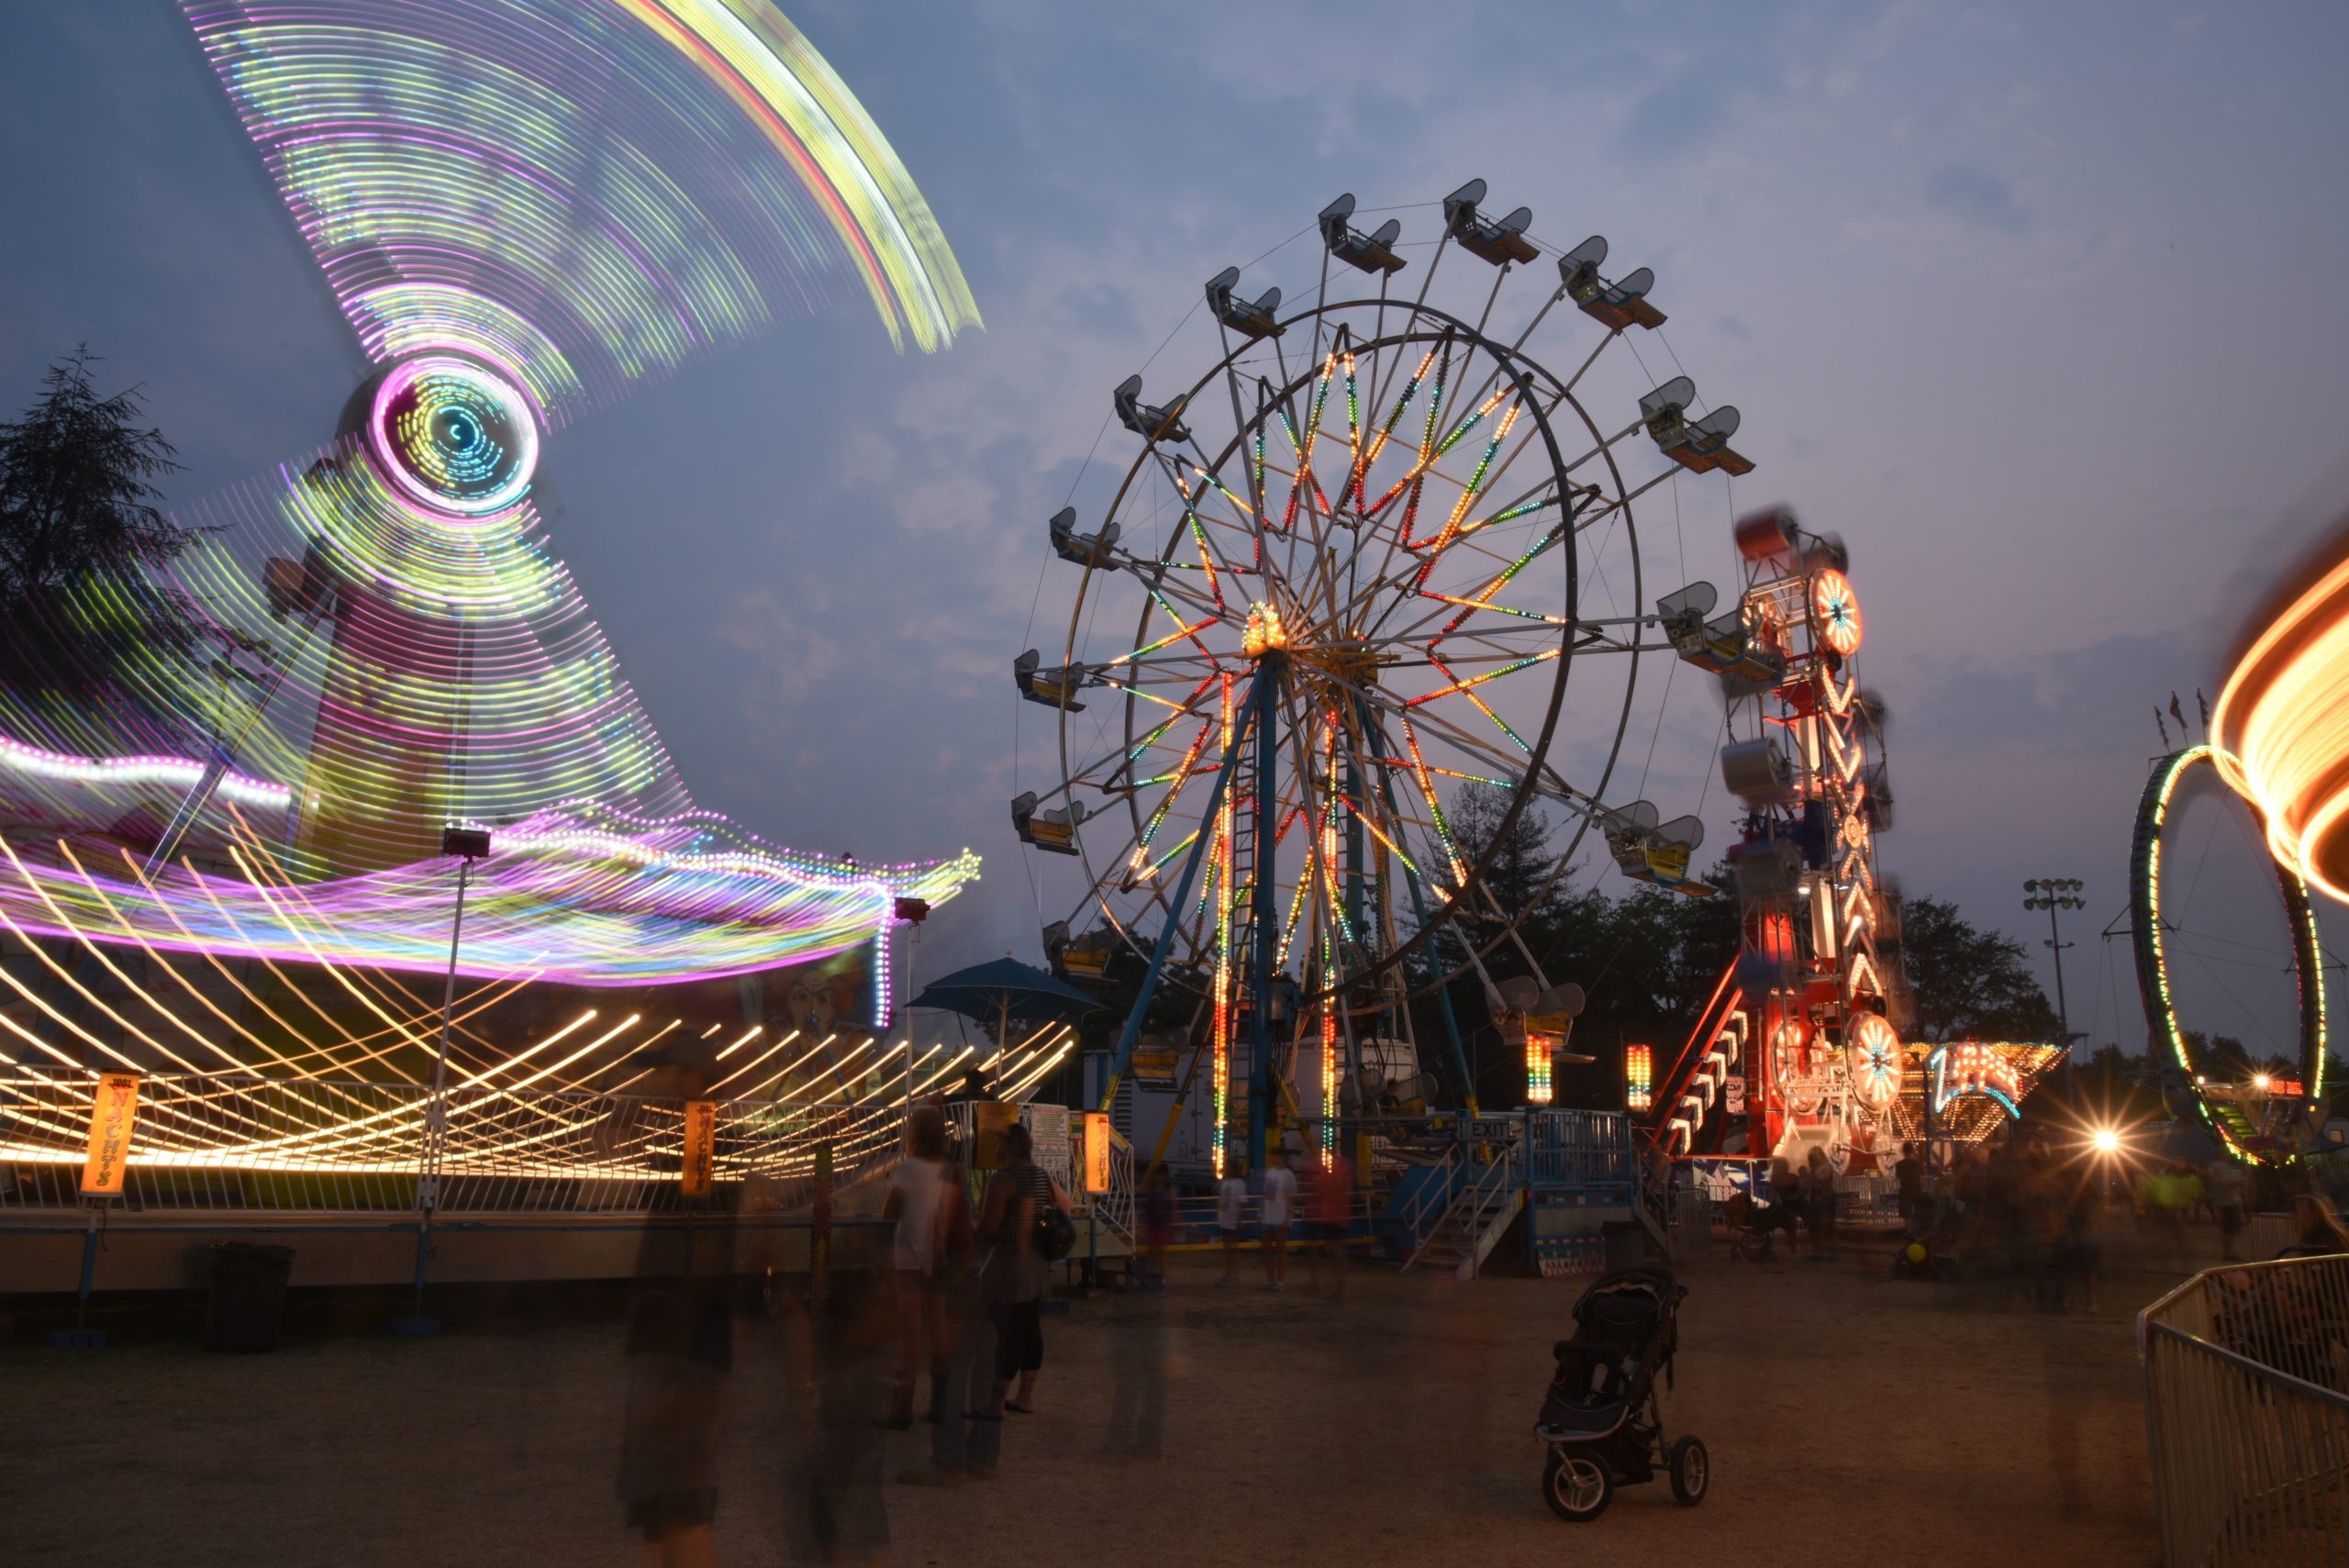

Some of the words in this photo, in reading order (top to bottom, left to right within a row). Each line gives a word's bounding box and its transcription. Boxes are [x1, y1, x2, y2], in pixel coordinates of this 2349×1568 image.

[112, 1078, 132, 1088] 1001
[1472, 1122, 1506, 1137] EXIT
[95, 1091, 128, 1186] NACHTS
